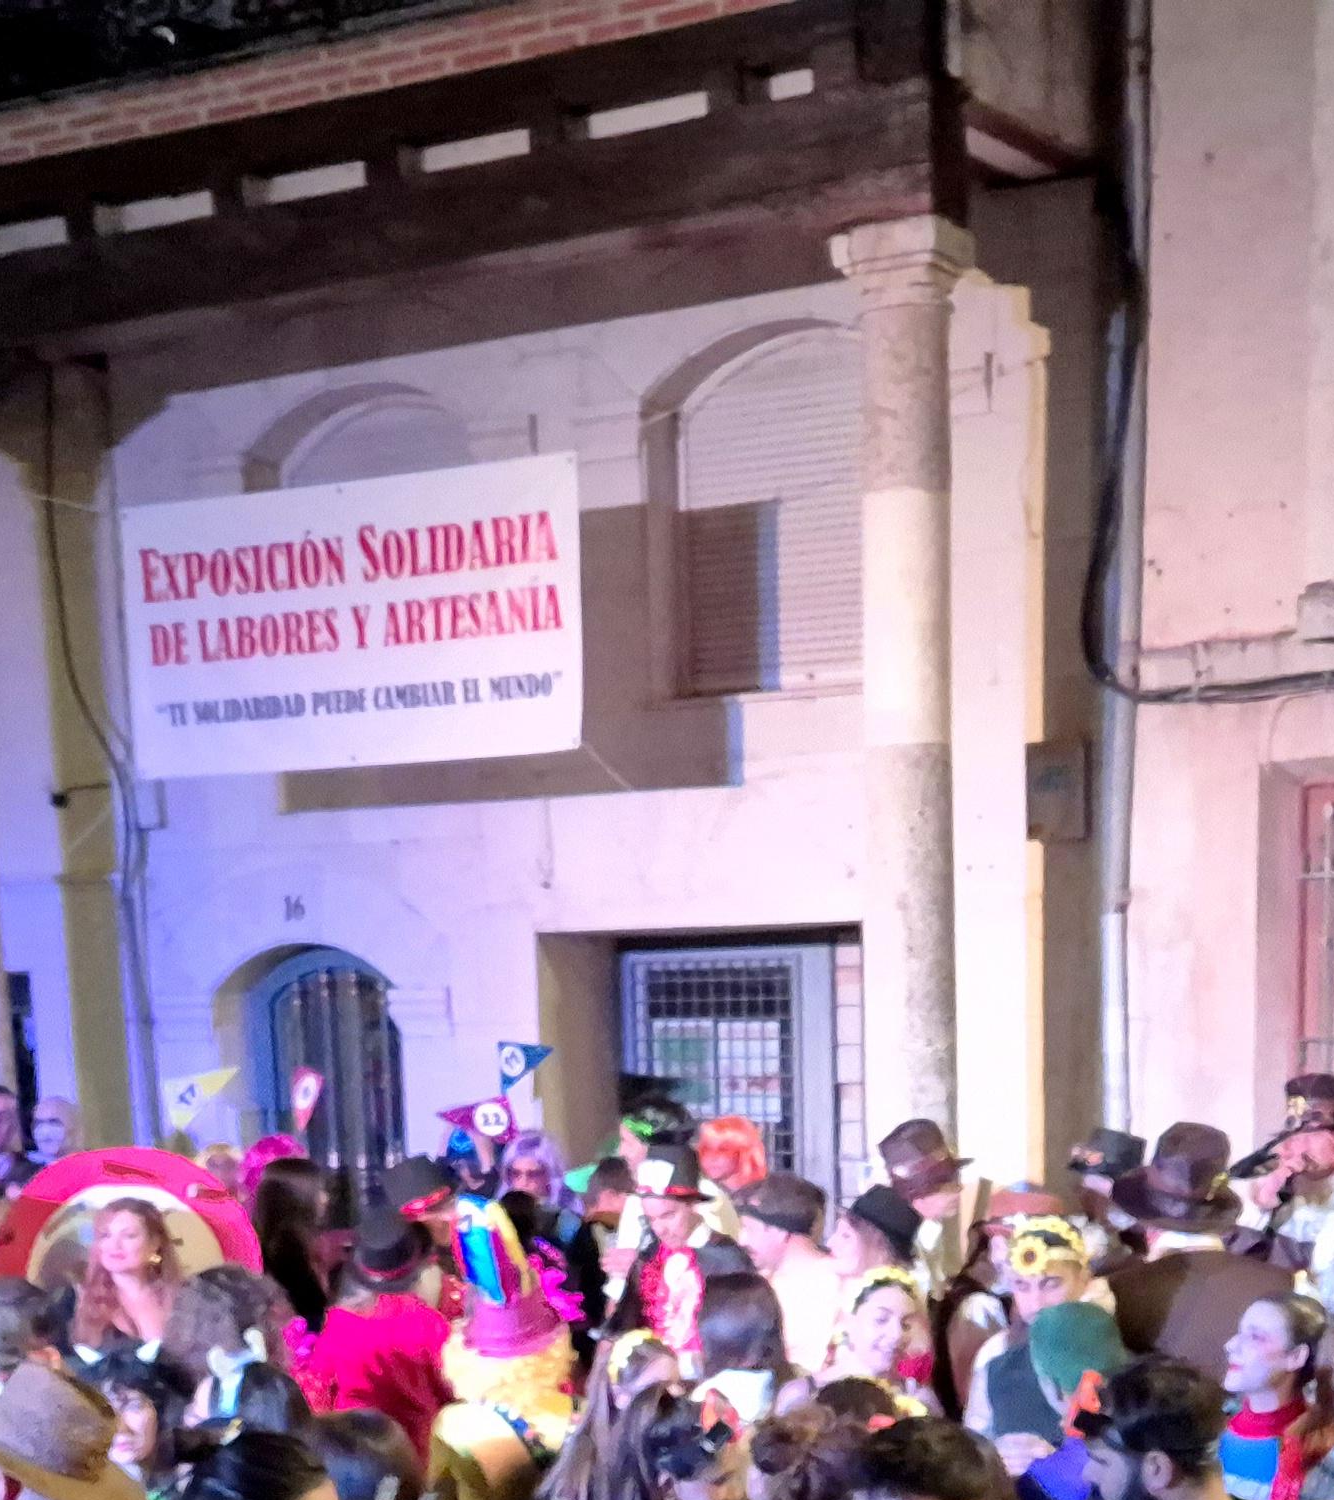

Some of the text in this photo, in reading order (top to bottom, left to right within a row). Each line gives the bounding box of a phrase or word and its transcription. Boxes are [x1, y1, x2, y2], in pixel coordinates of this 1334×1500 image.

[139, 510, 560, 603] EXPOSICIÓN SOLIDARIA
[149, 577, 565, 667] DE LABORES Y ARTESANÍA
[462, 677, 484, 705] EL
[284, 895, 306, 921] 16
